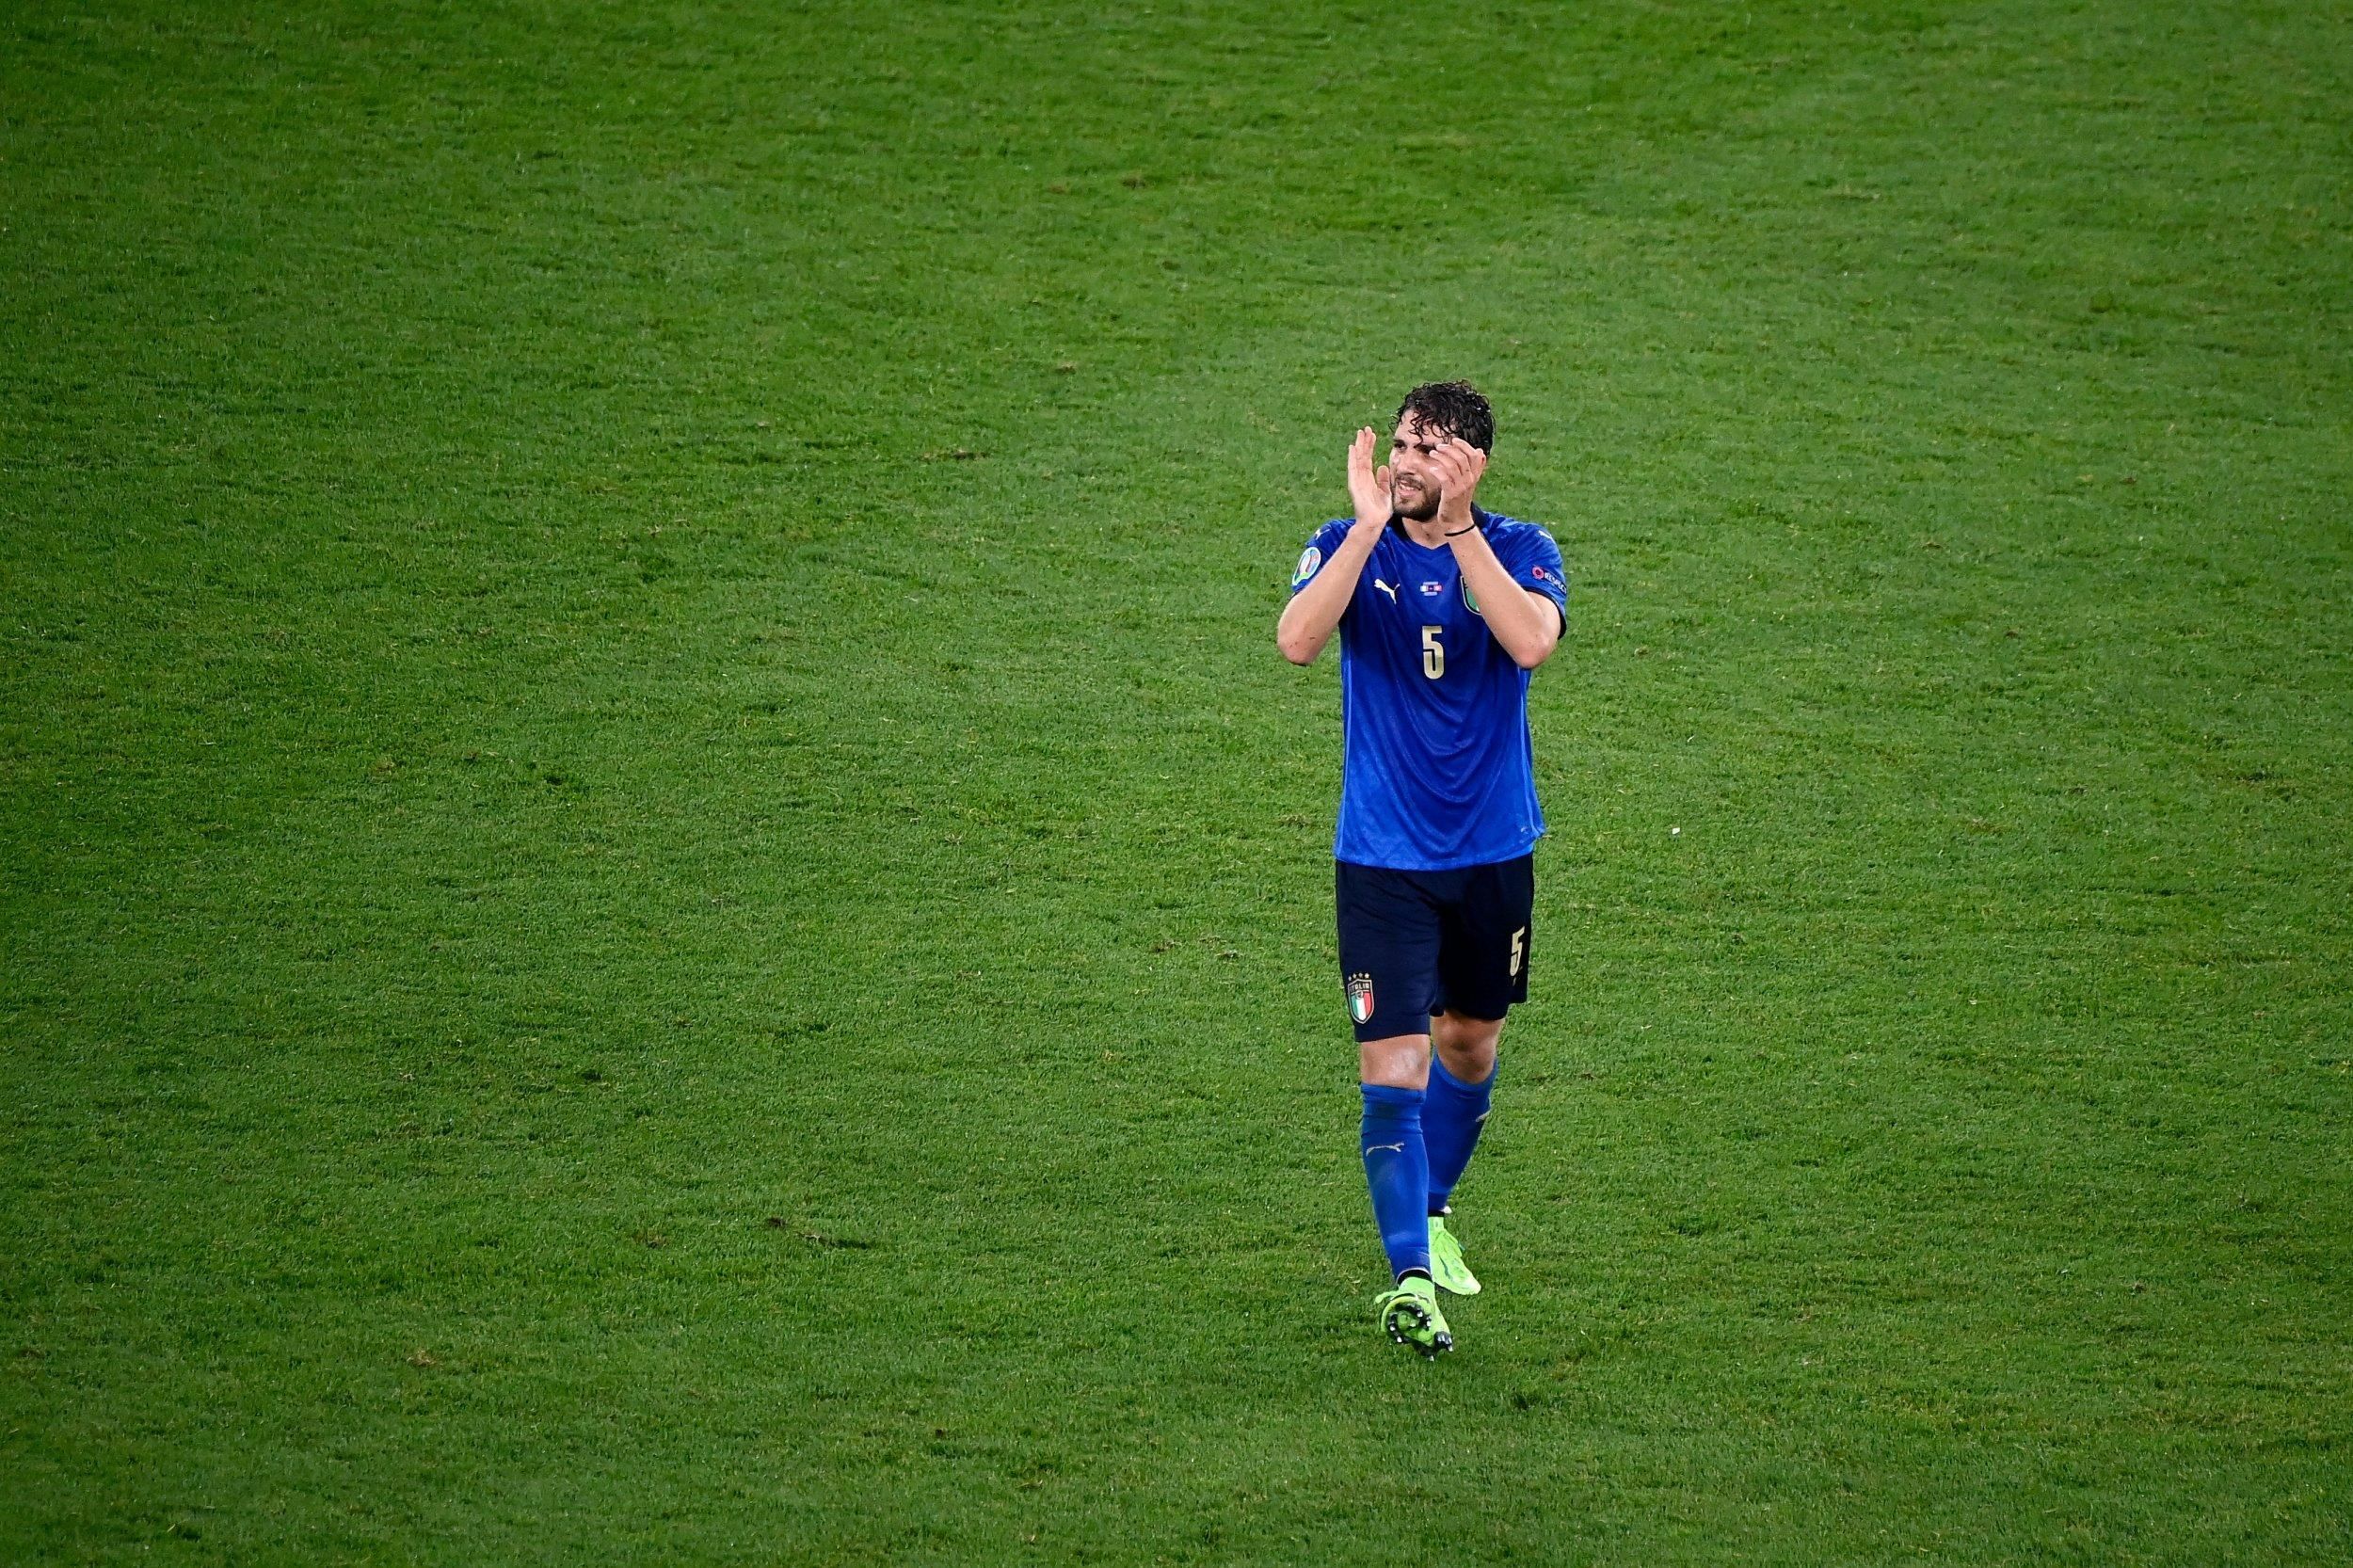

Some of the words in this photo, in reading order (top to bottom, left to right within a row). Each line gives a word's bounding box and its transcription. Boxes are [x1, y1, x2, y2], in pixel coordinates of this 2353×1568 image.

[1544, 572, 1567, 594] RESPEC
[1422, 625, 1444, 680] 5
[1510, 926, 1525, 977] 5
